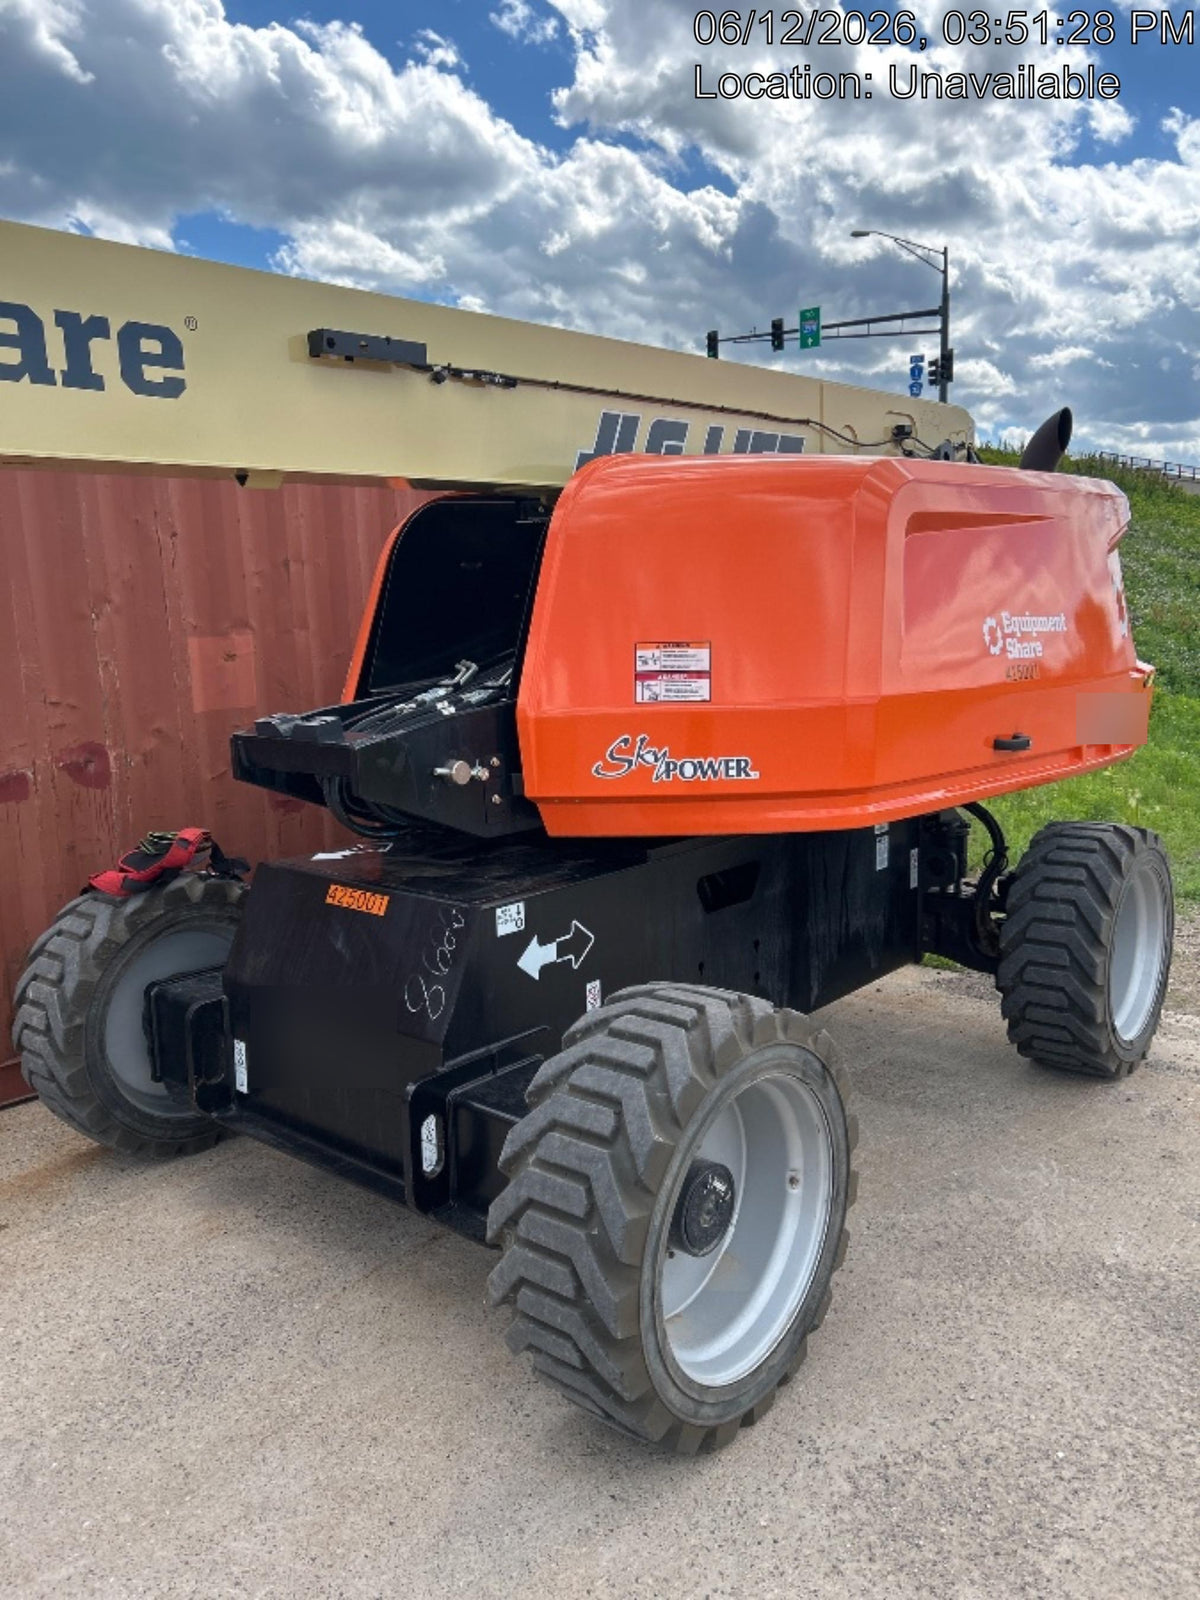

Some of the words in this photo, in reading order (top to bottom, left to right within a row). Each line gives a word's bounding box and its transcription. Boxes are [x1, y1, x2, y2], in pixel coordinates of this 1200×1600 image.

[1001, 610, 1067, 637] Equipment
[1006, 637, 1042, 660] Share
[327, 884, 387, 916] 425001
